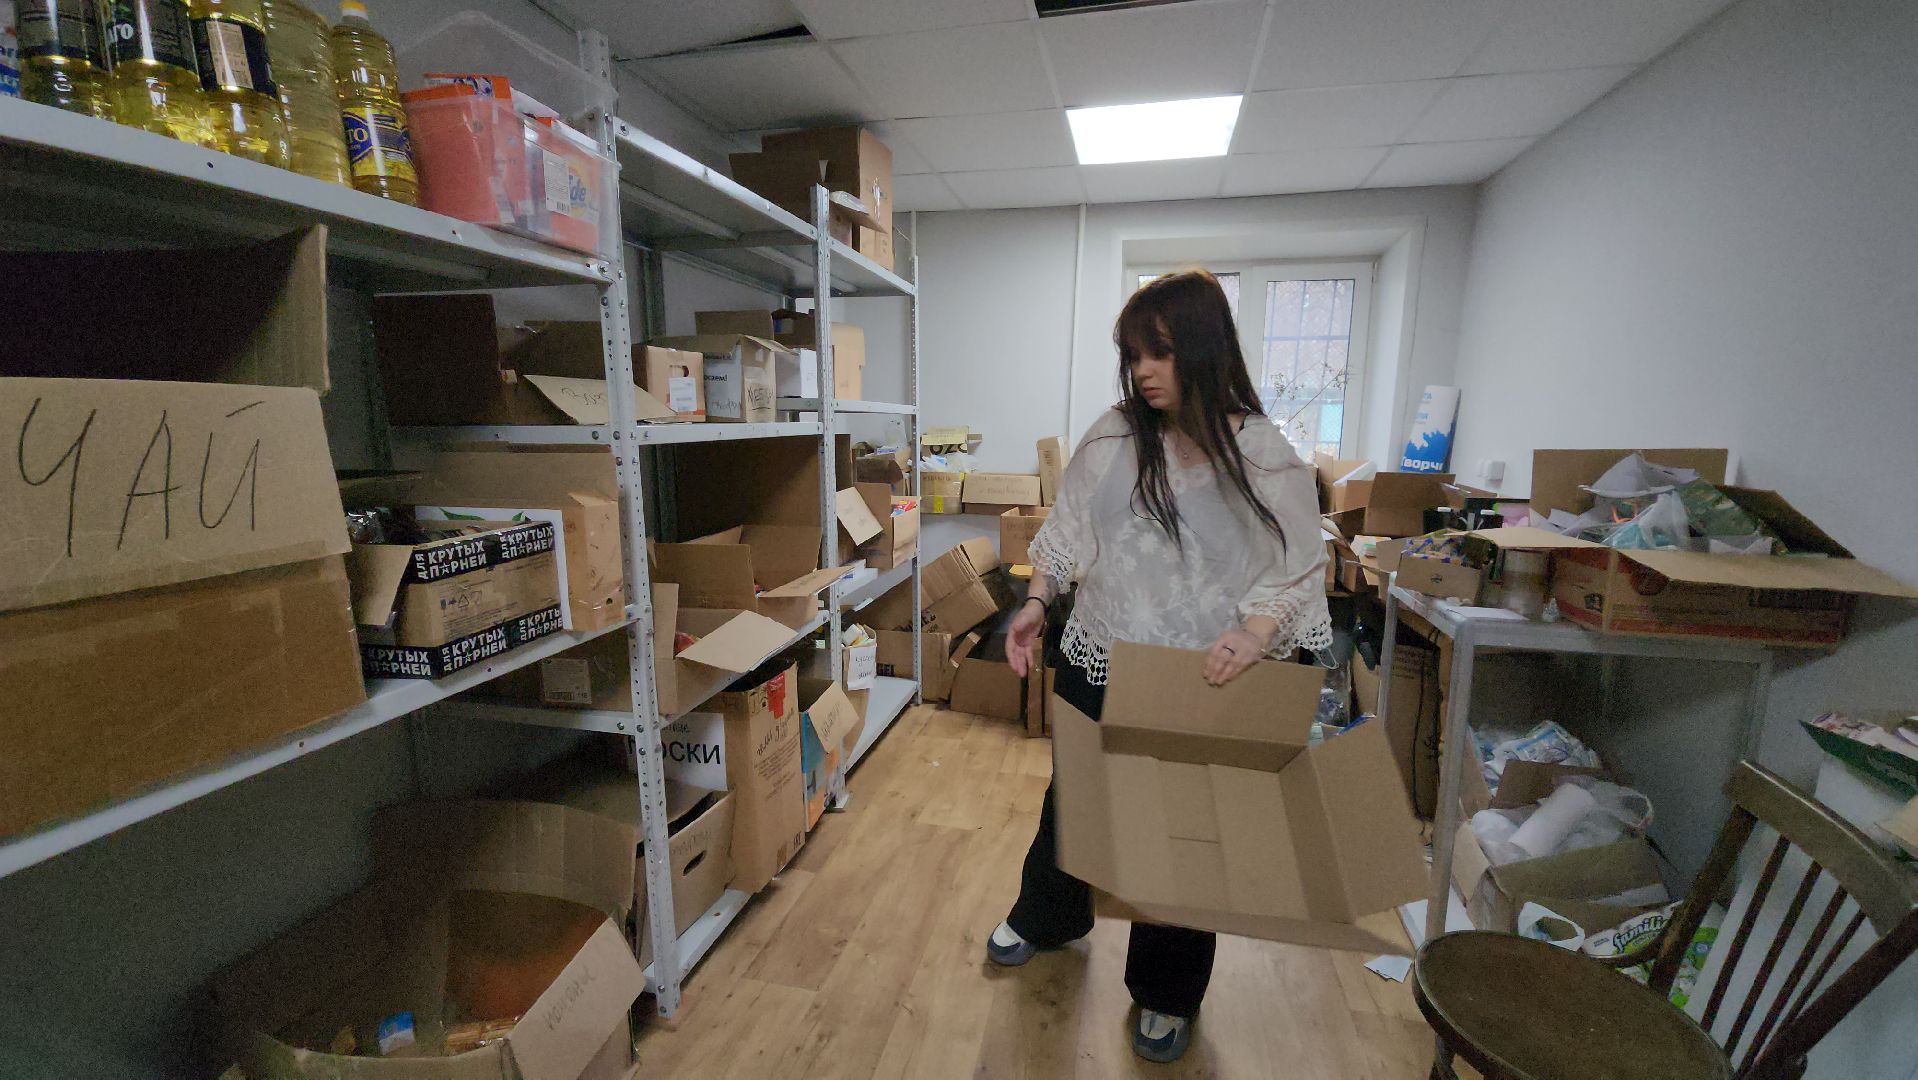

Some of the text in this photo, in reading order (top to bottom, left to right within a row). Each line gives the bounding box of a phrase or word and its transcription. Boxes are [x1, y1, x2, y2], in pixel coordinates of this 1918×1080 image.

[1402, 456, 1444, 471] ворч
[19, 398, 266, 557] ЧАЙ
[507, 526, 553, 545] КРУТЫХ
[428, 541, 485, 564] КРУТЫХ
[415, 553, 430, 580] ДЛЯ
[451, 626, 505, 656] КРУТЫХ
[367, 647, 429, 663] КРУТЫХ
[628, 735, 721, 765] СКИ
